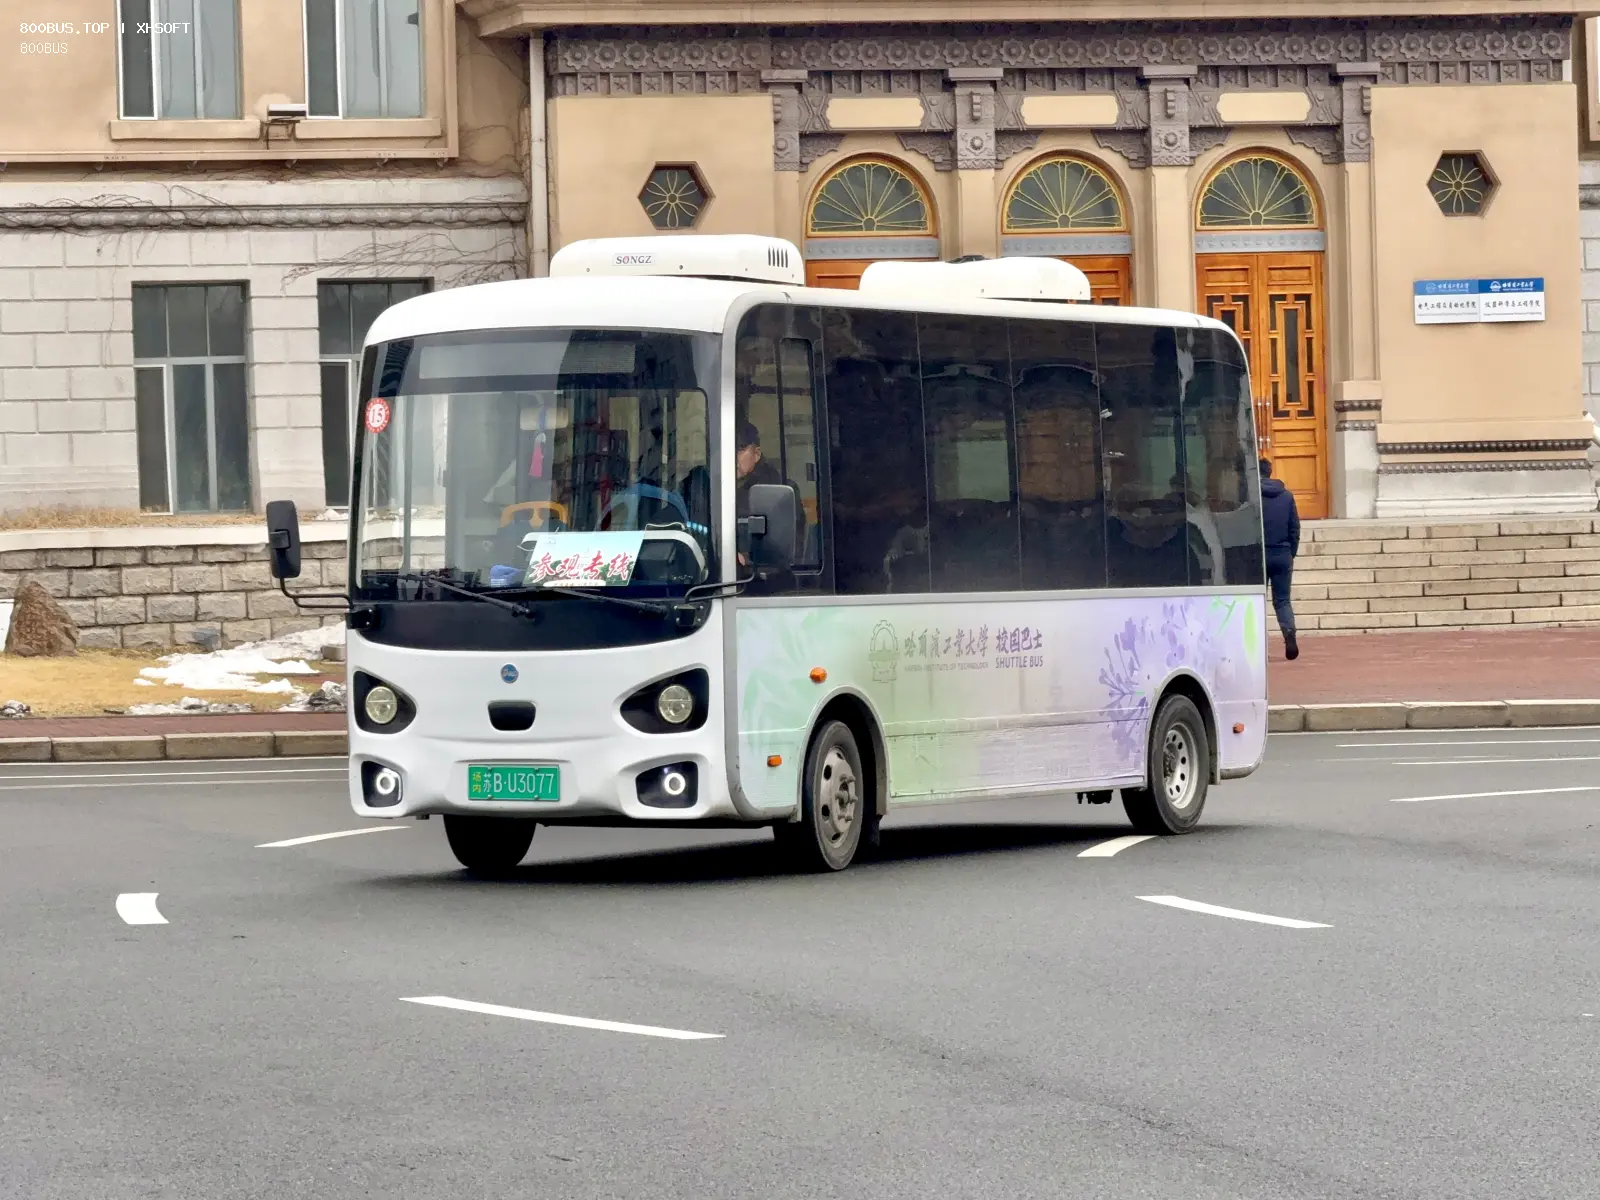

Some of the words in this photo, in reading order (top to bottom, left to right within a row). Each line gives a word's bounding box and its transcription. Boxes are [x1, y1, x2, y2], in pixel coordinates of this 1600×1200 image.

[615, 255, 652, 265] SONGZ
[371, 407, 384, 423] 15
[530, 550, 632, 583] 参观专线
[995, 626, 1043, 654] 校园巴士
[995, 656, 1028, 669] SHUTTLE
[1029, 655, 1044, 668] BUS
